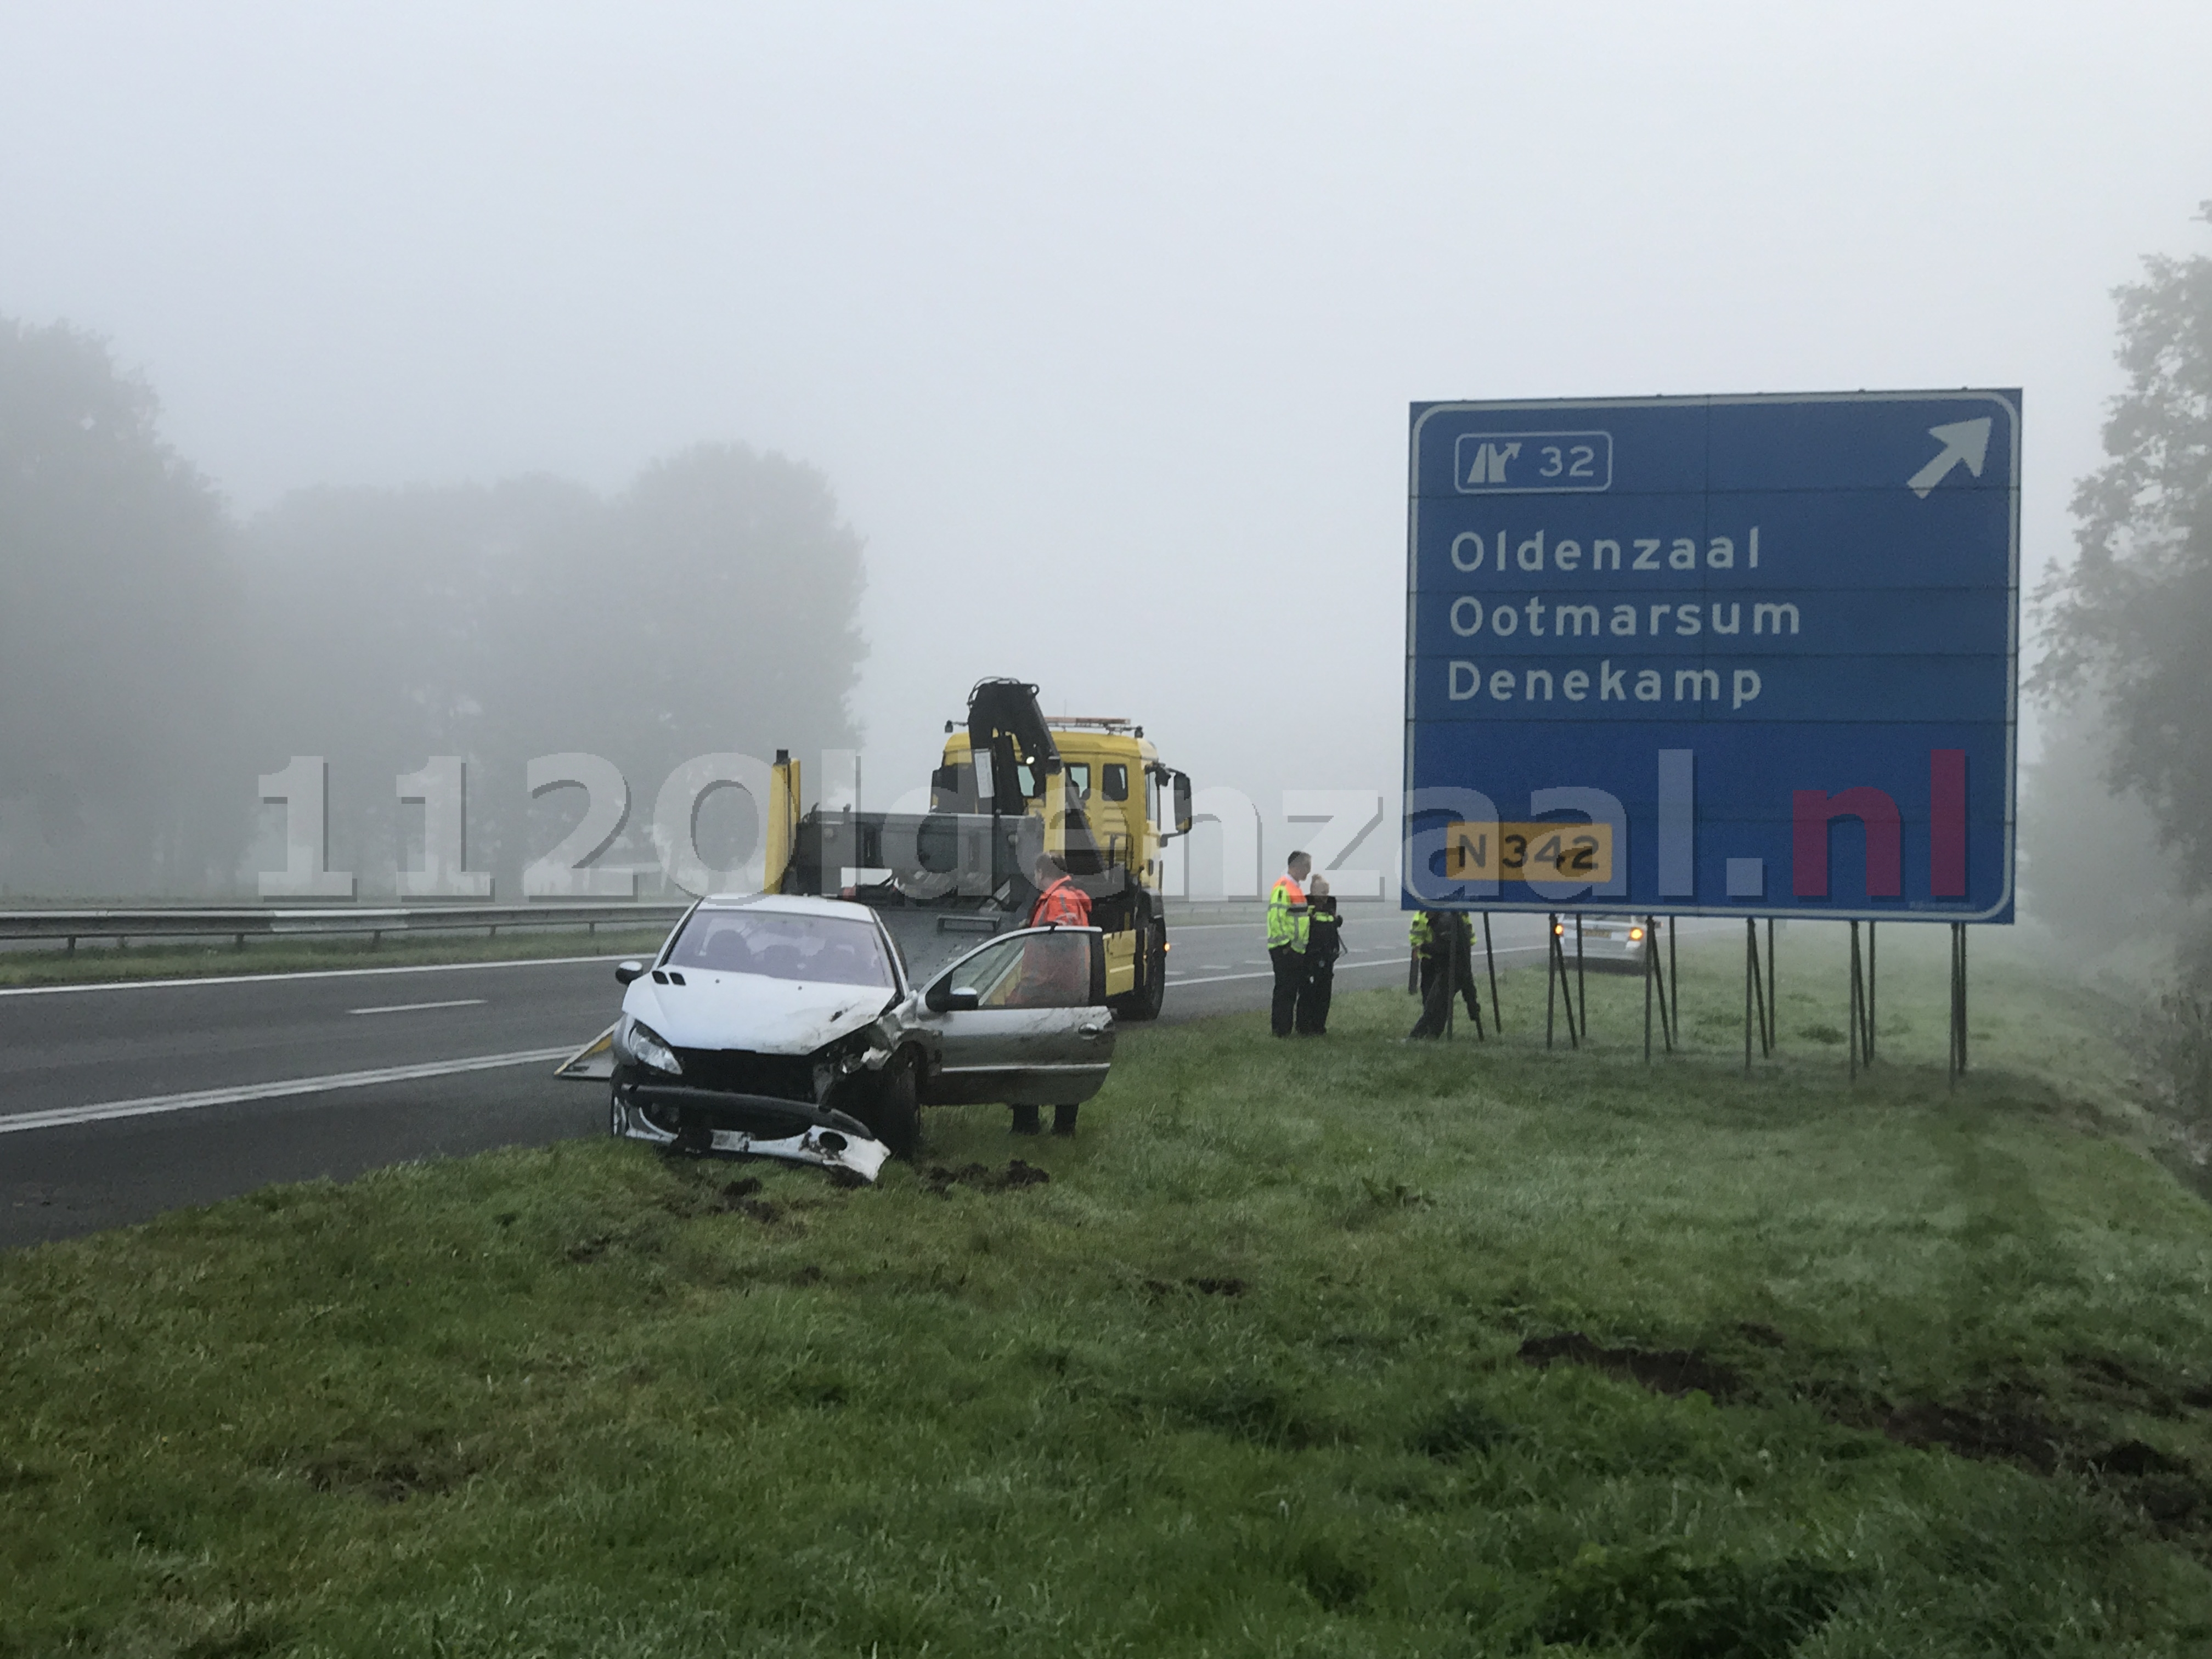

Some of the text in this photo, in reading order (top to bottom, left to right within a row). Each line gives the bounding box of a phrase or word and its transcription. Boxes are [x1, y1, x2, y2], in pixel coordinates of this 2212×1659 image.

[1539, 446, 1595, 477] 32
[1450, 527, 1759, 571] Oldenzaal
[1449, 595, 1800, 637] Ootmarsum
[1449, 661, 1762, 709] Denekamp
